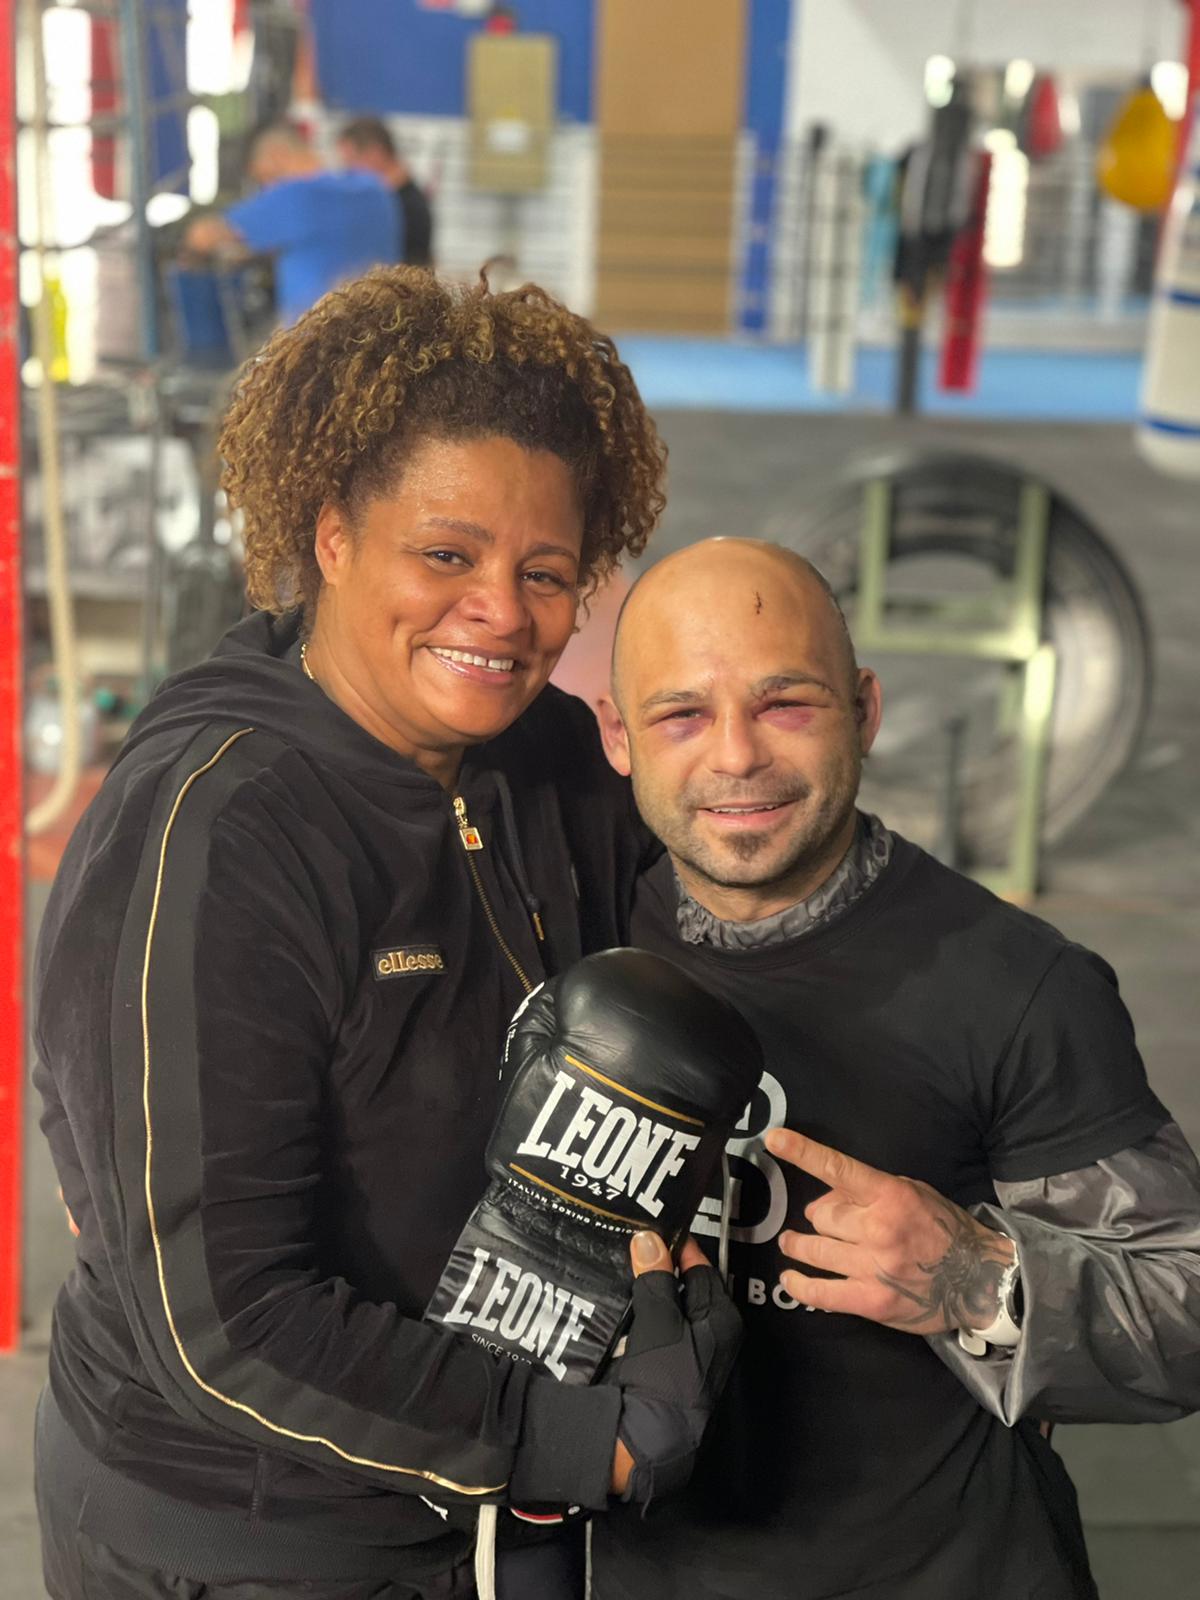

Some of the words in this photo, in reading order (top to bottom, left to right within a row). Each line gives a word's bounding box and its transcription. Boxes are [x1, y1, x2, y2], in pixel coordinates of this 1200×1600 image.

[378, 950, 444, 974] ellesse
[516, 1070, 702, 1219] LEONE
[507, 1177, 549, 1205] ITALIAN
[551, 1202, 592, 1224] BOXING
[559, 1164, 622, 1201] 1947
[442, 1246, 596, 1382] LEONE
[747, 1276, 833, 1314] BO
[471, 1333, 504, 1357] SINCE
